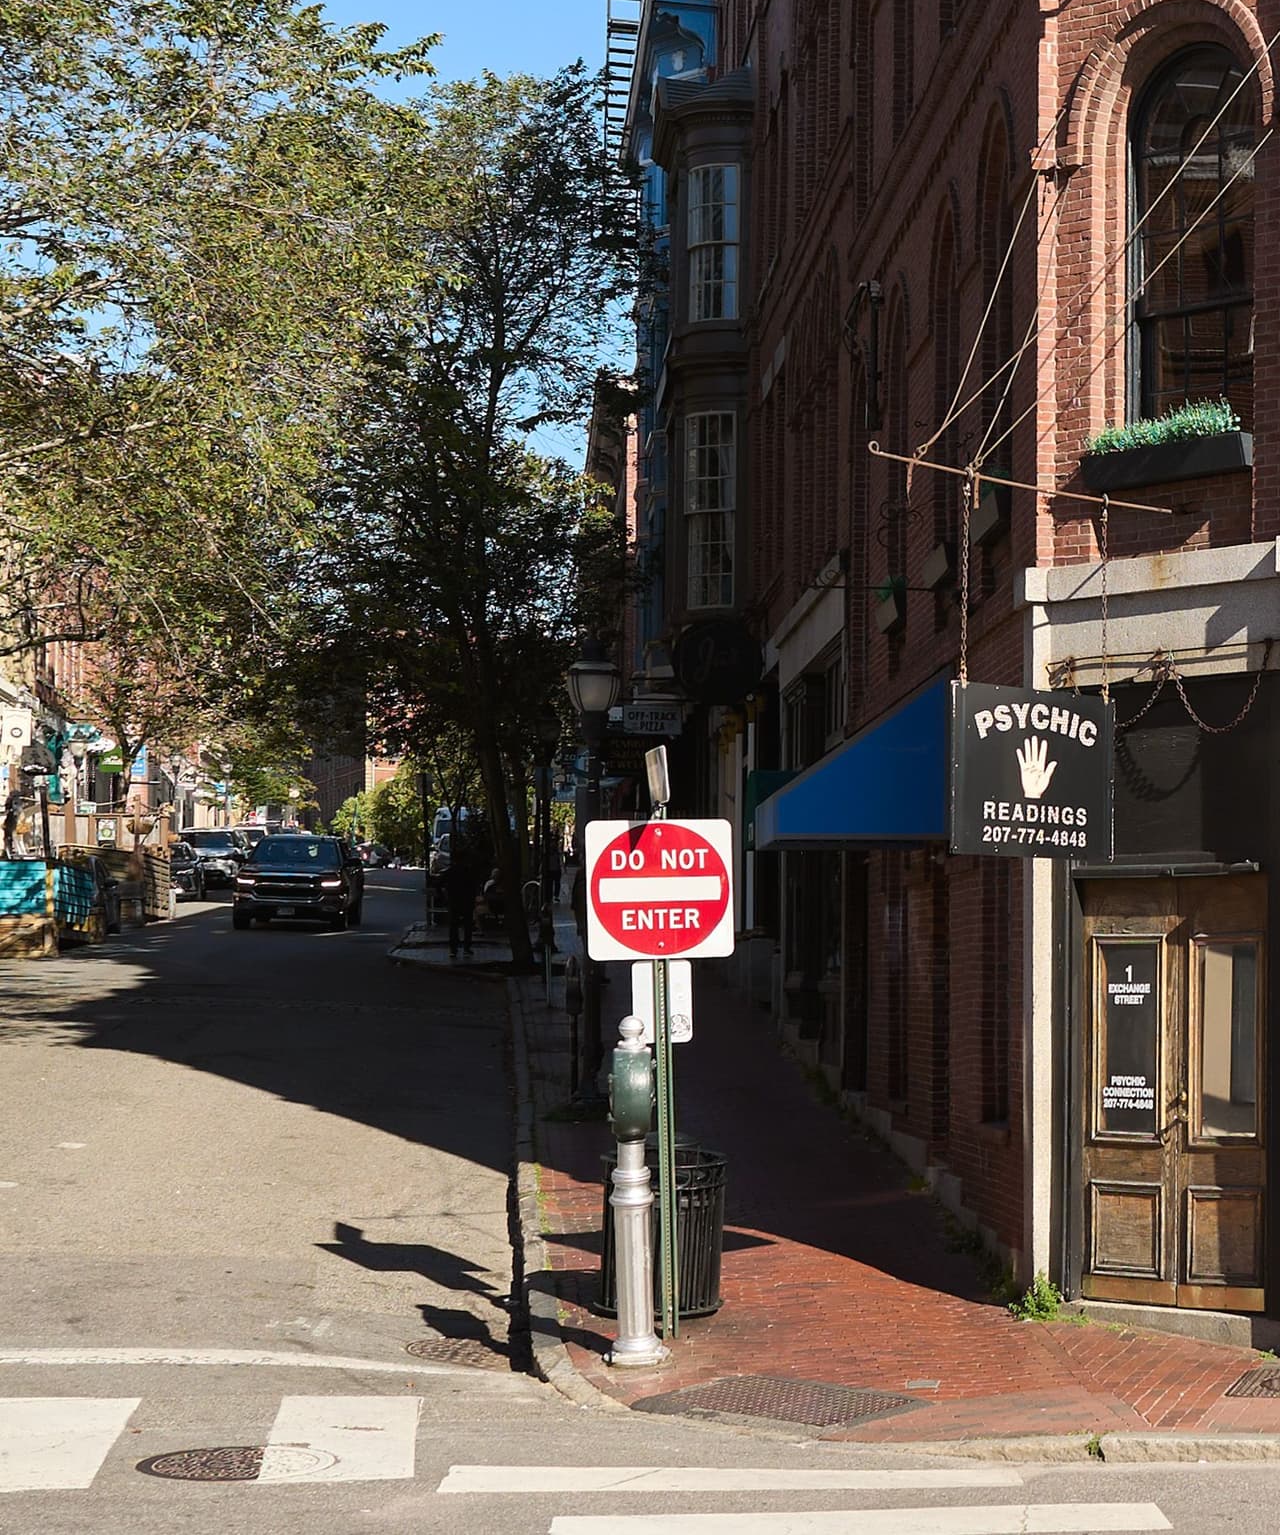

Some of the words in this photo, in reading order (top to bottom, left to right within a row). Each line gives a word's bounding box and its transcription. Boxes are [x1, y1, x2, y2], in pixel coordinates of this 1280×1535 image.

[628, 711, 678, 721] OFF-TRACK
[640, 722, 665, 732] PIZZA
[974, 703, 1098, 747] PSYCHIC
[983, 801, 1087, 826] READINGS
[982, 826, 1088, 848] 207-774-4848
[611, 850, 645, 871] DO
[661, 848, 709, 869] NOT
[622, 908, 700, 930] ENTER
[1125, 965, 1133, 982] 1
[1108, 984, 1150, 994] EXCHANGE
[1114, 995, 1144, 1005] STREET
[1111, 1076, 1146, 1086] PSYCHIC
[1103, 1087, 1154, 1098] CONNECTION
